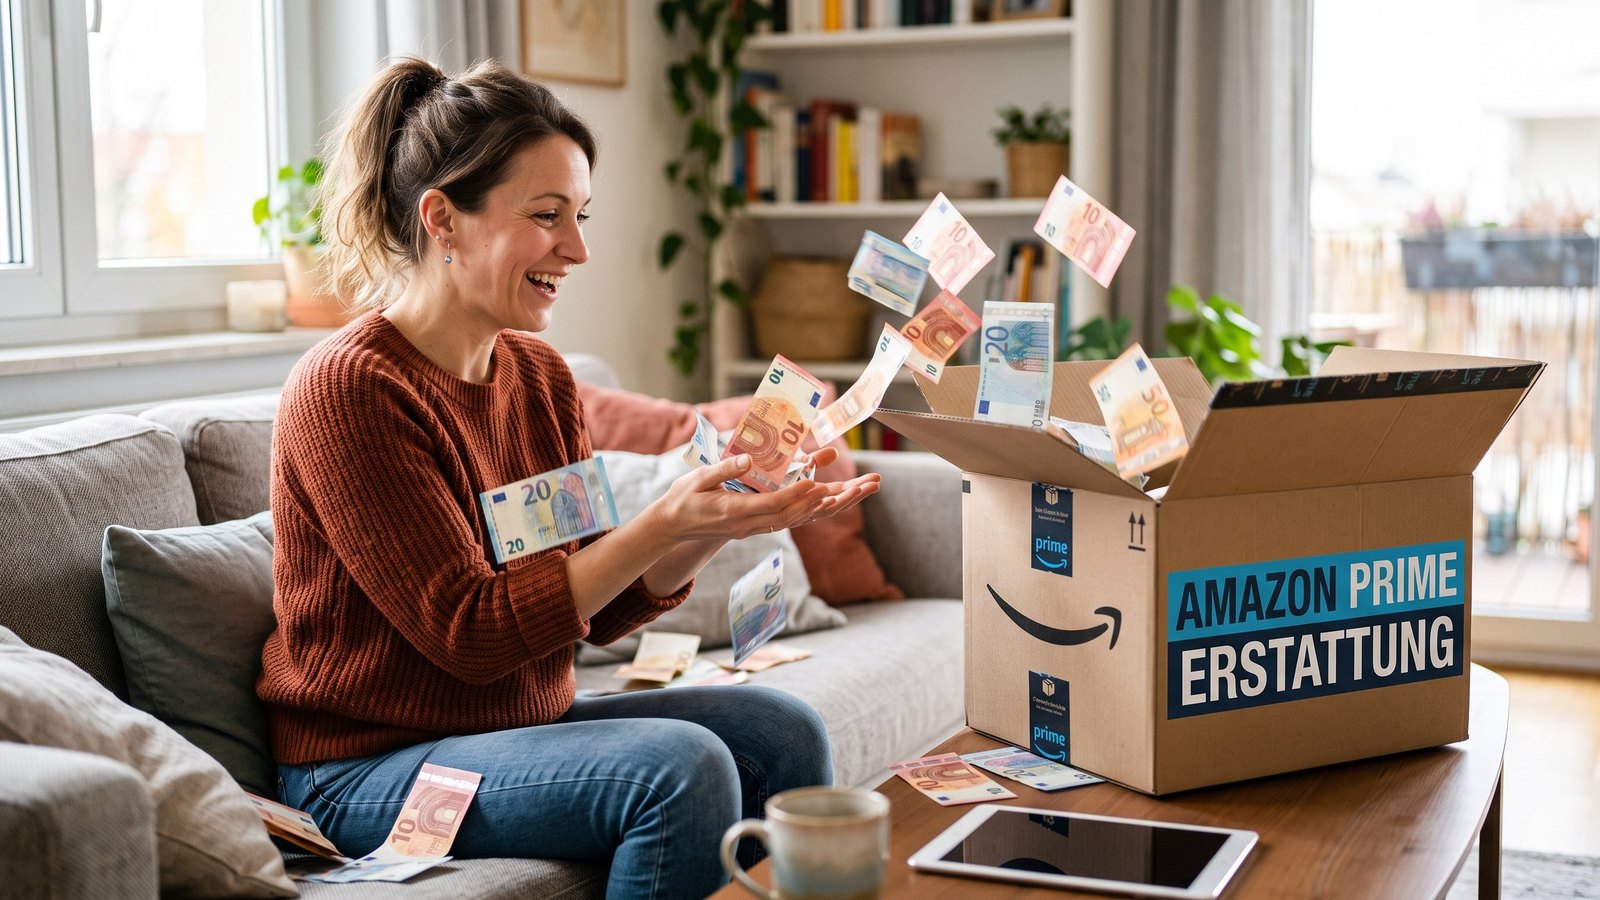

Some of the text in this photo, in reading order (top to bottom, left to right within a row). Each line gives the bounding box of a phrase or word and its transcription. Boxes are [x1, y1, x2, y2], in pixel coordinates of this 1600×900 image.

[1082, 202, 1100, 225] 10
[910, 236, 922, 250] 10
[950, 221, 968, 243] 10
[880, 336, 891, 352] 10
[985, 325, 1010, 356] 20
[768, 368, 784, 385] 10
[925, 364, 938, 376] 10
[1141, 384, 1169, 417] 50
[781, 420, 805, 446] 10
[521, 478, 551, 507] 20
[506, 538, 525, 555] 20
[1035, 536, 1068, 555] prime
[764, 577, 781, 600] 20
[1175, 551, 1457, 632] AMAZON PRIME
[1181, 615, 1454, 706] ERSTATTUNG
[1033, 726, 1066, 747] prime
[1003, 769, 1036, 779] 20
[916, 780, 944, 791] 10
[392, 819, 416, 844] 10
